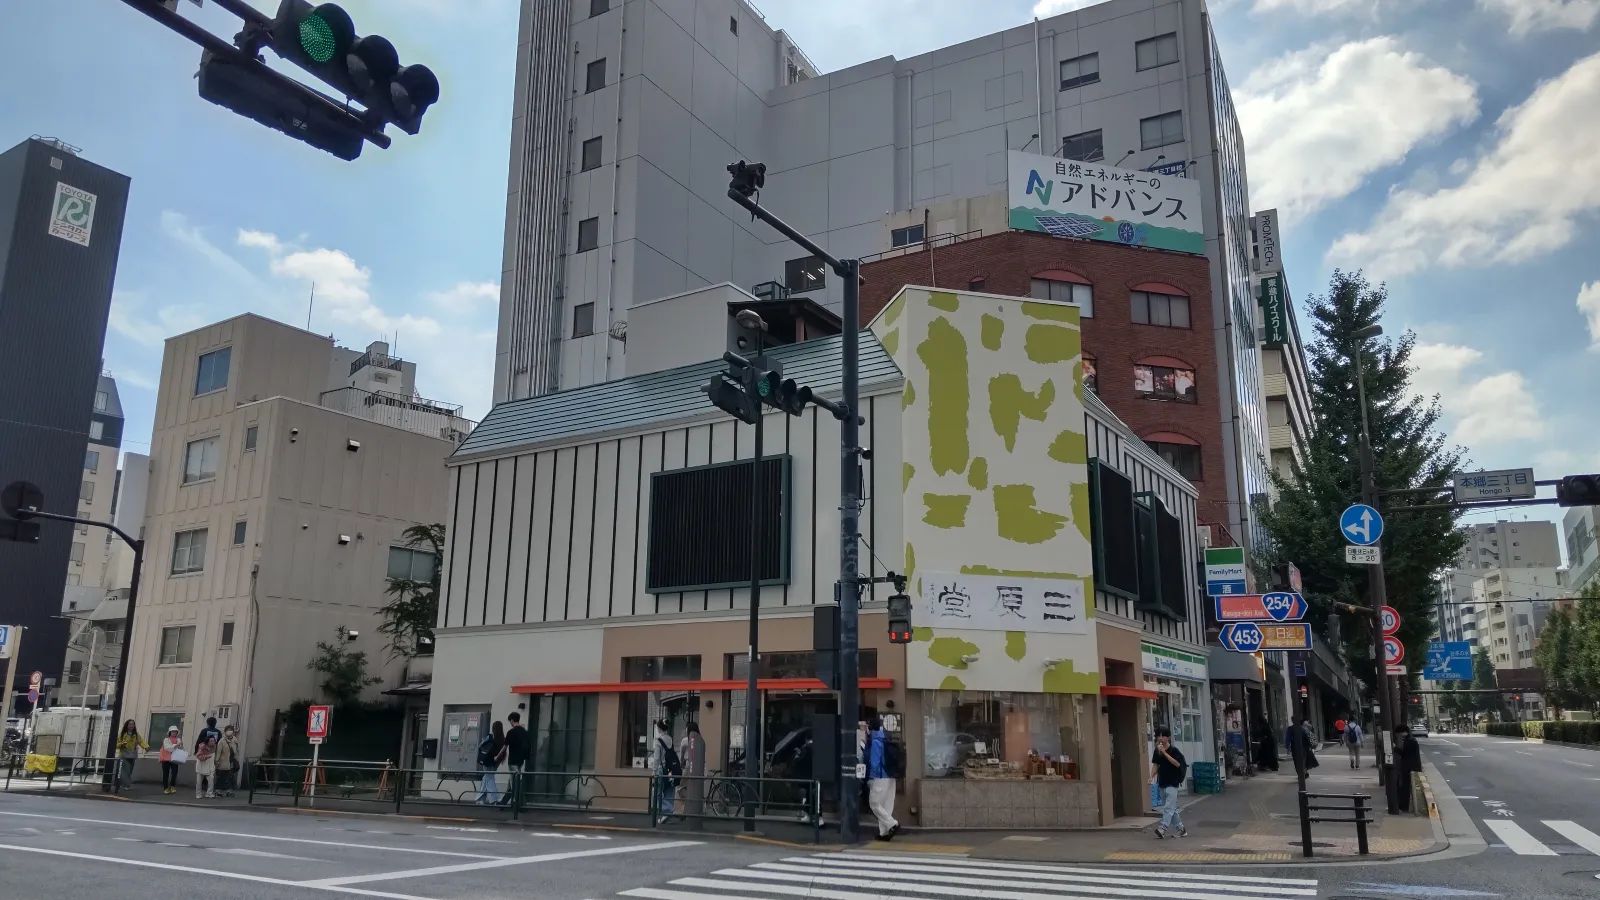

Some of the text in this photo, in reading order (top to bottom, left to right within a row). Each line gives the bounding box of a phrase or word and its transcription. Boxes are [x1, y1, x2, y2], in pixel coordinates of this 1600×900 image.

[1055, 161, 1161, 190] 自然エネルギーの
[59, 184, 94, 202] TOYOTA
[1061, 181, 1188, 220] アドバンス
[1267, 278, 1282, 342] 東進ハイスクール
[1460, 473, 1527, 489] 本郷三丁目
[1208, 567, 1243, 576] FamilyMart
[1222, 584, 1232, 594] 酒
[1266, 596, 1290, 610] 254
[1235, 629, 1260, 645] 453
